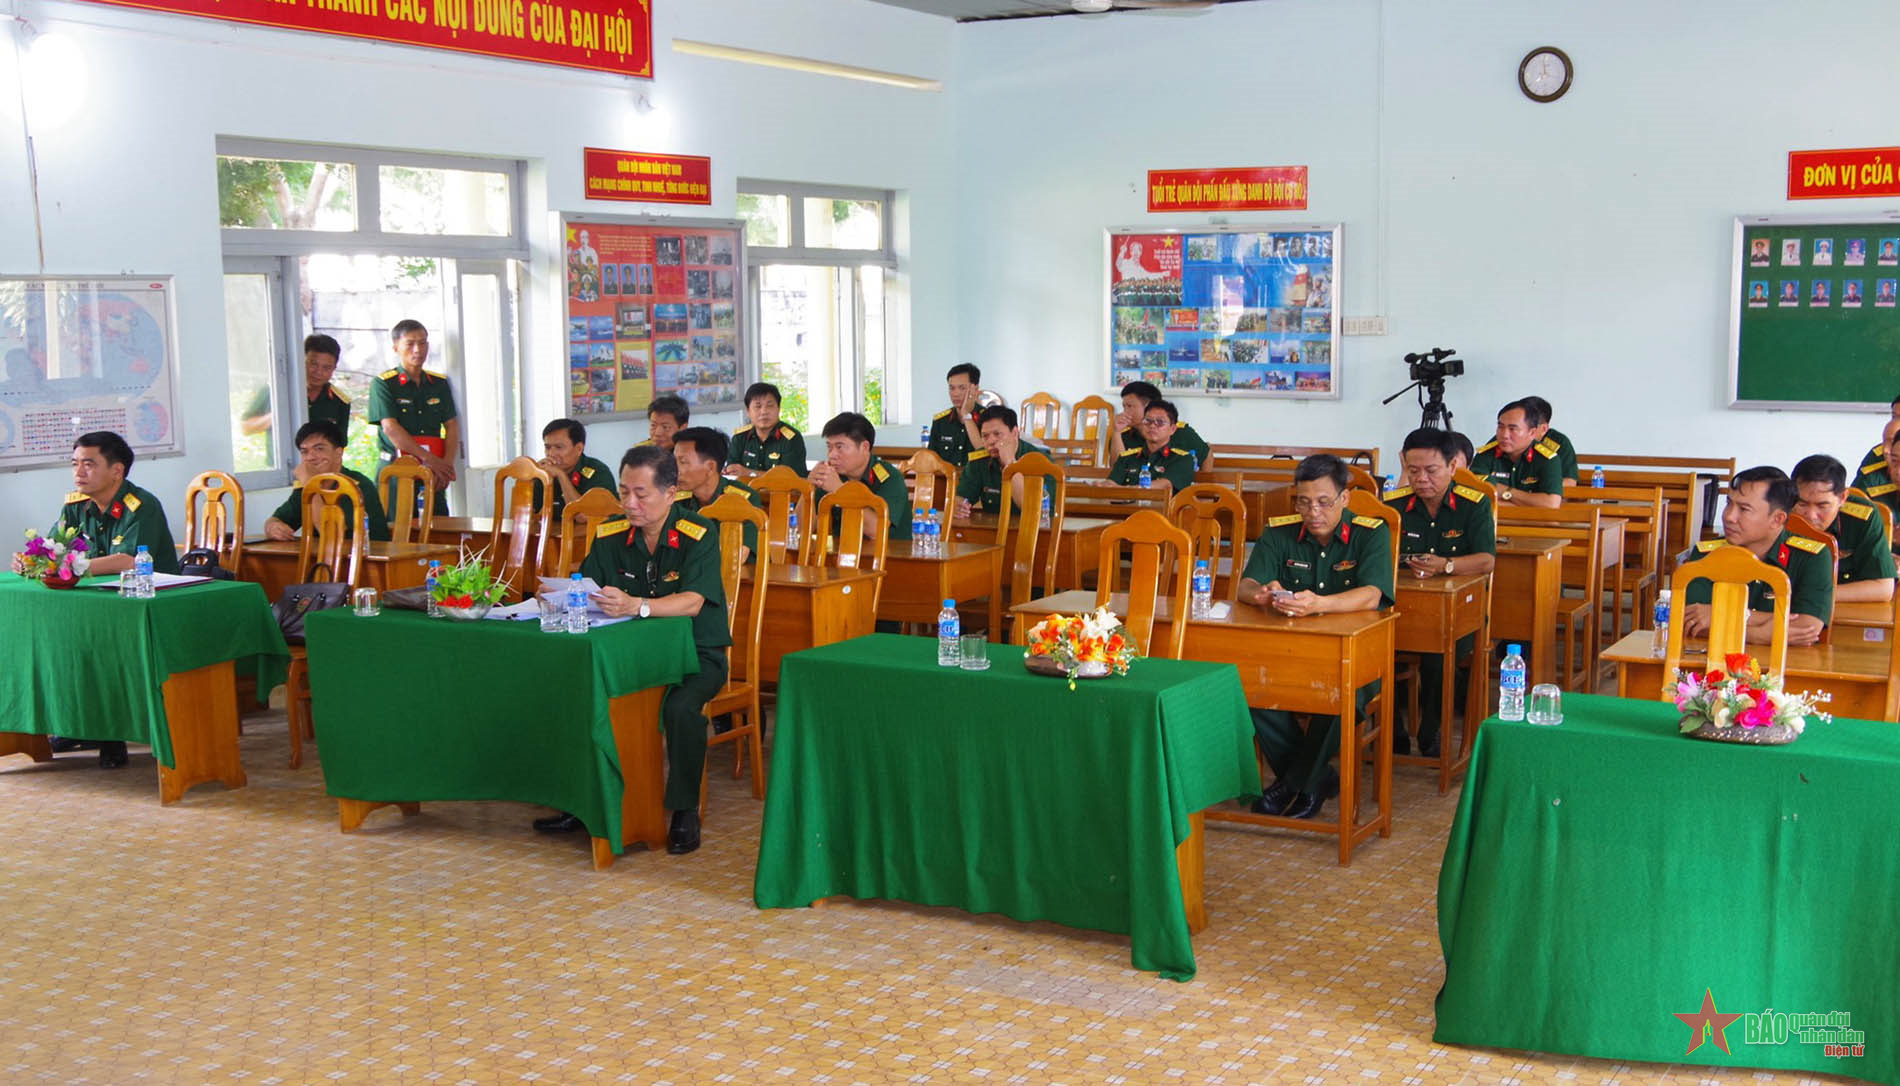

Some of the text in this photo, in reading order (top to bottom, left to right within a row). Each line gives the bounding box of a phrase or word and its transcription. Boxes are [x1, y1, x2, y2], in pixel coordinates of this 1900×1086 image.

[434, 0, 467, 39] NỘI
[474, 0, 525, 39] DUNG
[530, 0, 567, 45] CỦA
[570, 8, 600, 58] ĐẠI
[604, 7, 633, 63] HỘI
[1803, 163, 1837, 187] ĐƠN
[1840, 164, 1857, 190] VỊ
[1861, 156, 1893, 185] CỦA
